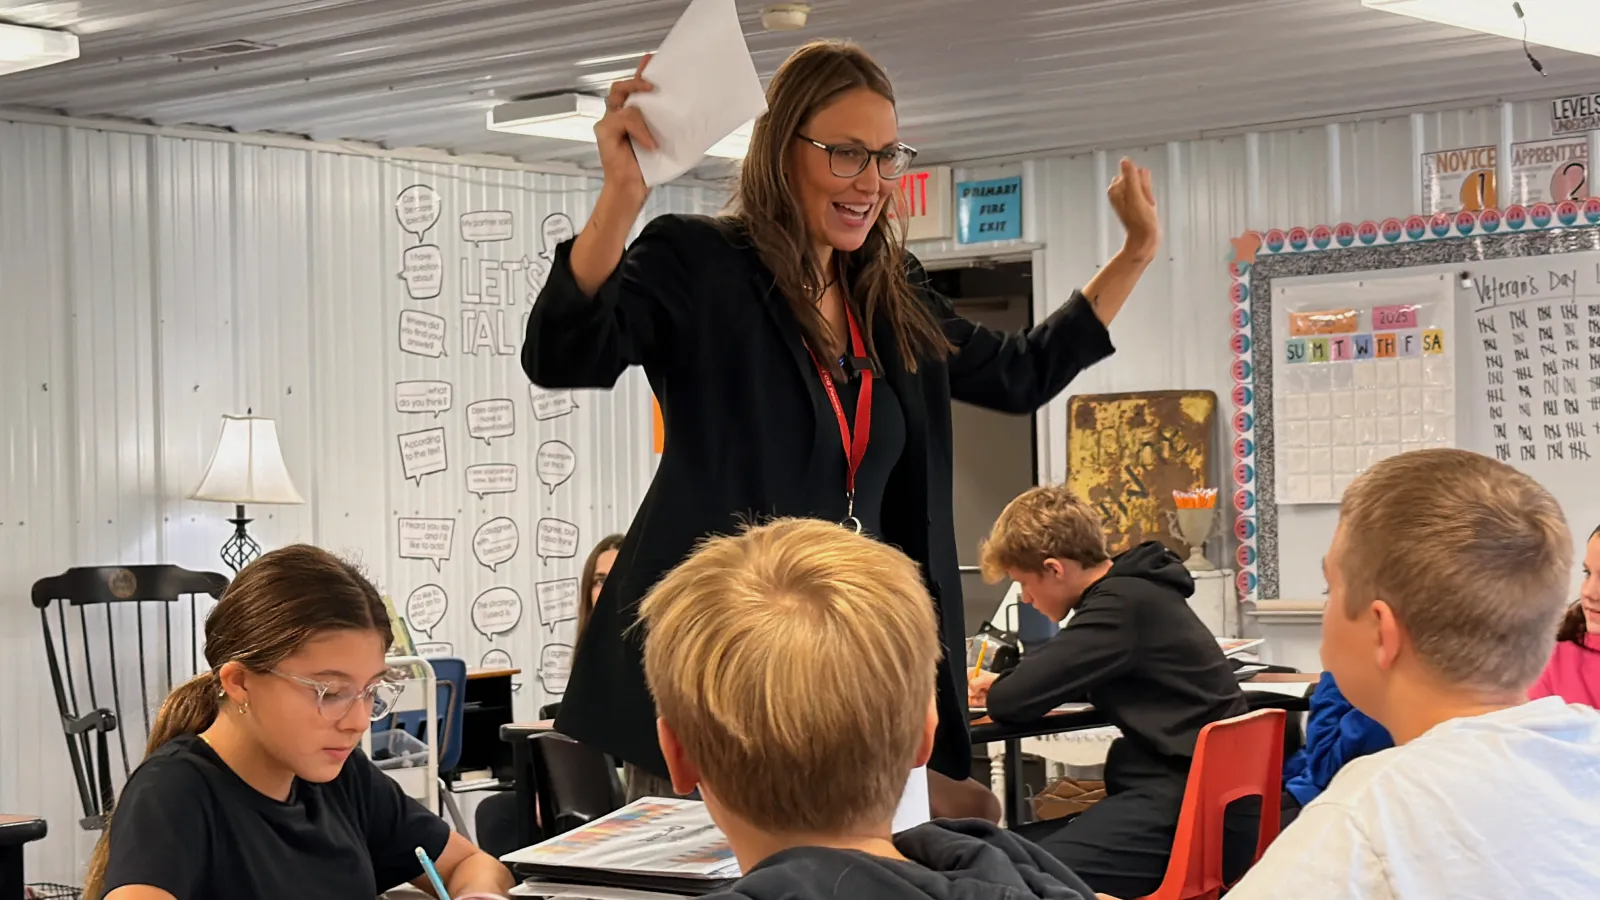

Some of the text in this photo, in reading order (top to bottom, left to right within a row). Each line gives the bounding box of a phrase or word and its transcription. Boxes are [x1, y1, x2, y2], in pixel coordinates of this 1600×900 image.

[1552, 95, 1600, 120] LEVELS
[1436, 147, 1497, 174] NOVICE
[1512, 142, 1588, 166] APPRENTICE
[963, 183, 1018, 198] PRIMARY
[1478, 173, 1485, 204] 1
[1562, 162, 1585, 201] 2
[979, 203, 1006, 216] FIRE
[978, 221, 1007, 233] EXIT
[1548, 269, 1577, 303] Day
[461, 309, 530, 357] TAL
[1287, 334, 1442, 360] SU M T W TH F SA
[411, 399, 425, 408] you
[404, 435, 441, 449] According
[414, 450, 426, 460] the
[405, 520, 426, 530] heard
[427, 523, 439, 531] you
[424, 532, 438, 540] and
